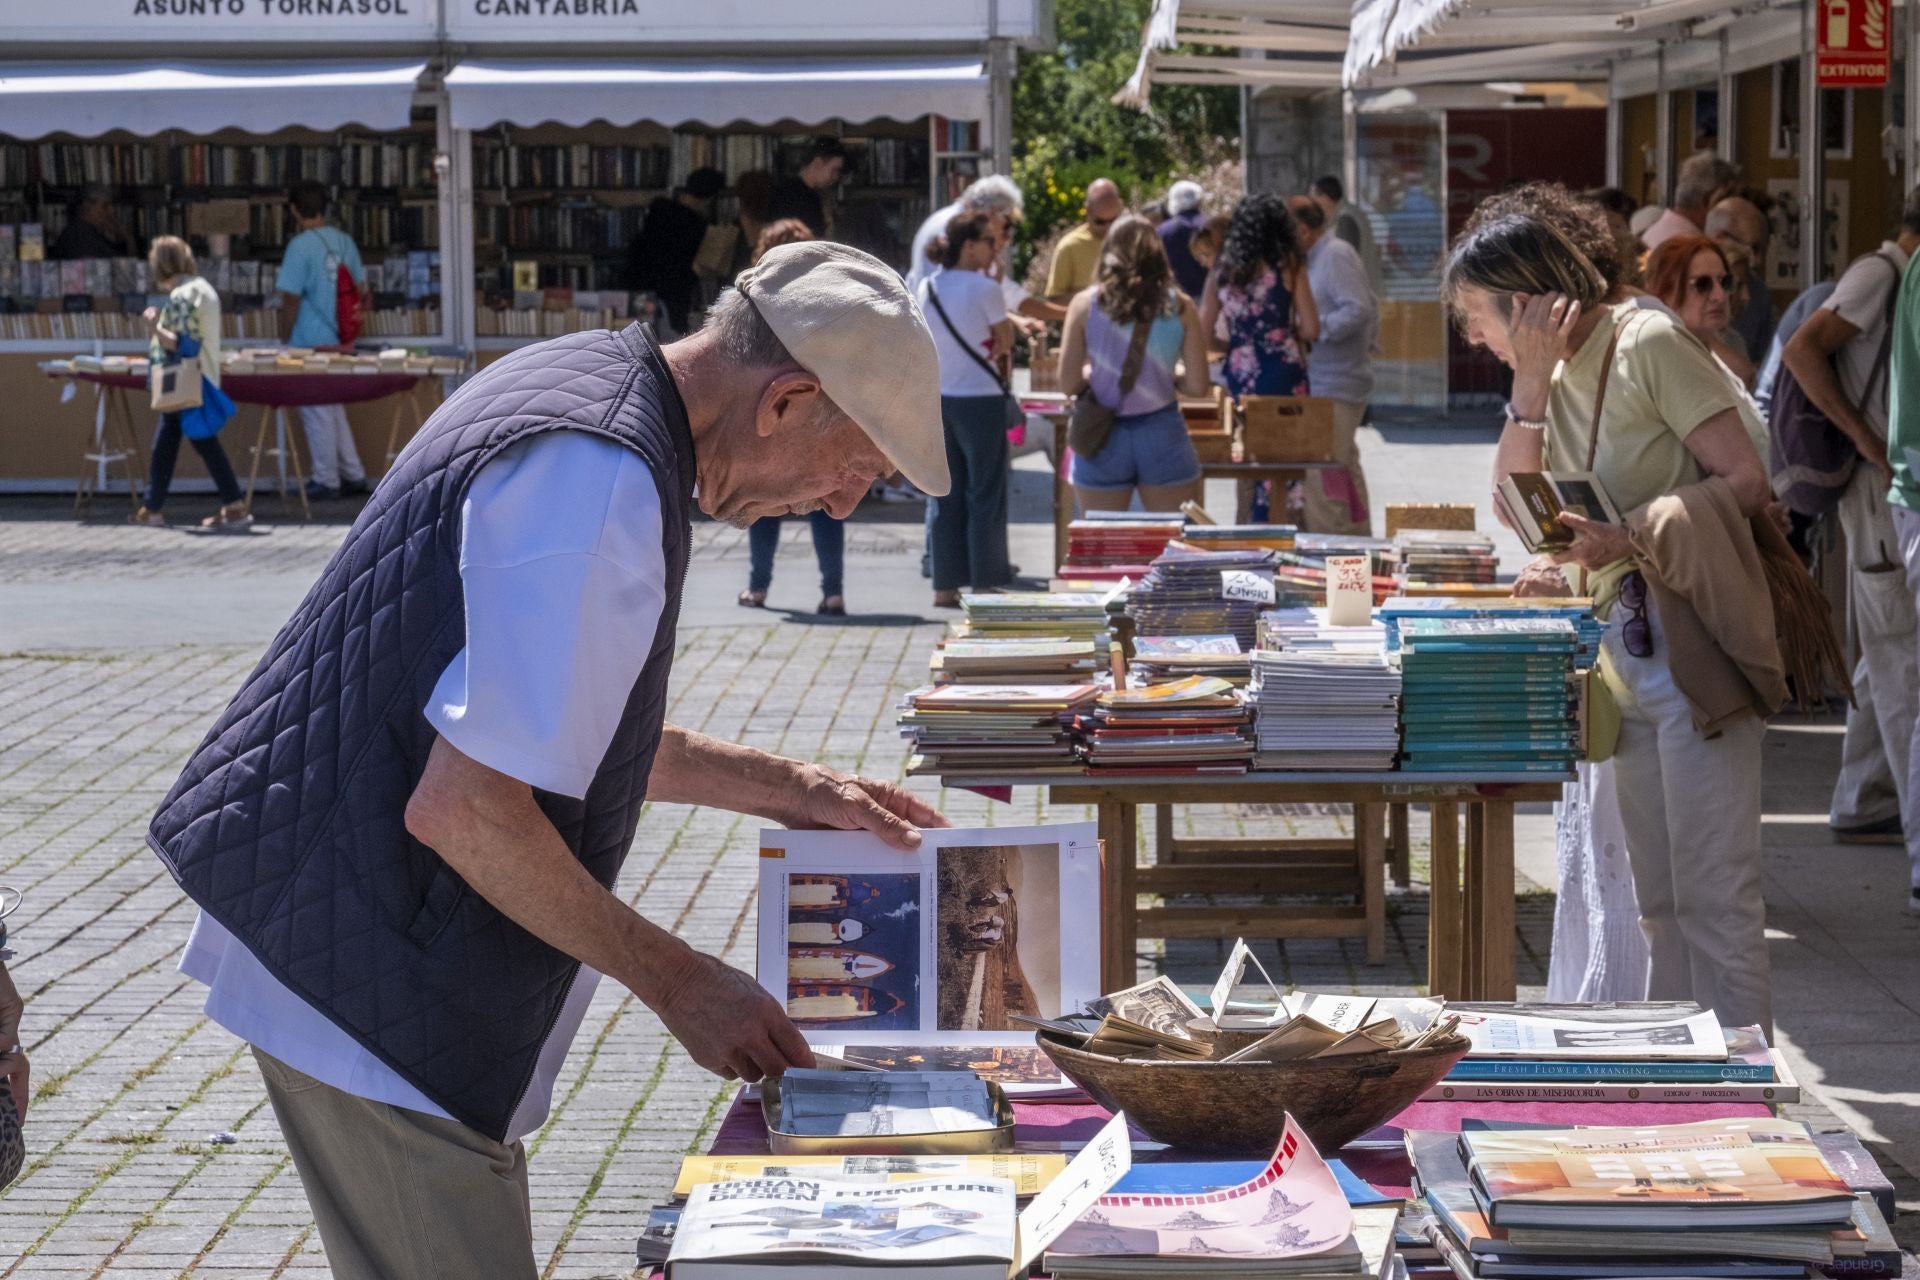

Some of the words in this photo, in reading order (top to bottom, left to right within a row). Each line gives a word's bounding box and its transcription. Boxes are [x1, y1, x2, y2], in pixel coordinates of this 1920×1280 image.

[134, 0, 244, 15] ASUNTO
[261, 0, 408, 15] TORNASOL
[475, 0, 638, 15] CANTABRIA
[1820, 64, 1885, 77] EXTINTOR
[1226, 586, 1269, 600] DISNEY
[1494, 1064, 1528, 1073] FRESH
[1535, 1064, 1578, 1074] FLOWER
[1585, 1066, 1650, 1075] ARRANGING
[1477, 1088, 1493, 1098] LAS
[1495, 1088, 1524, 1098] OBRAS
[1527, 1088, 1540, 1098] DE
[1542, 1088, 1605, 1098] MISERICORDIA
[1702, 1090, 1740, 1098] BARCELONA
[711, 1180, 820, 1190] URBAN
[835, 1184, 1003, 1197] FURNITURE
[709, 1193, 818, 1202] DESIGN
